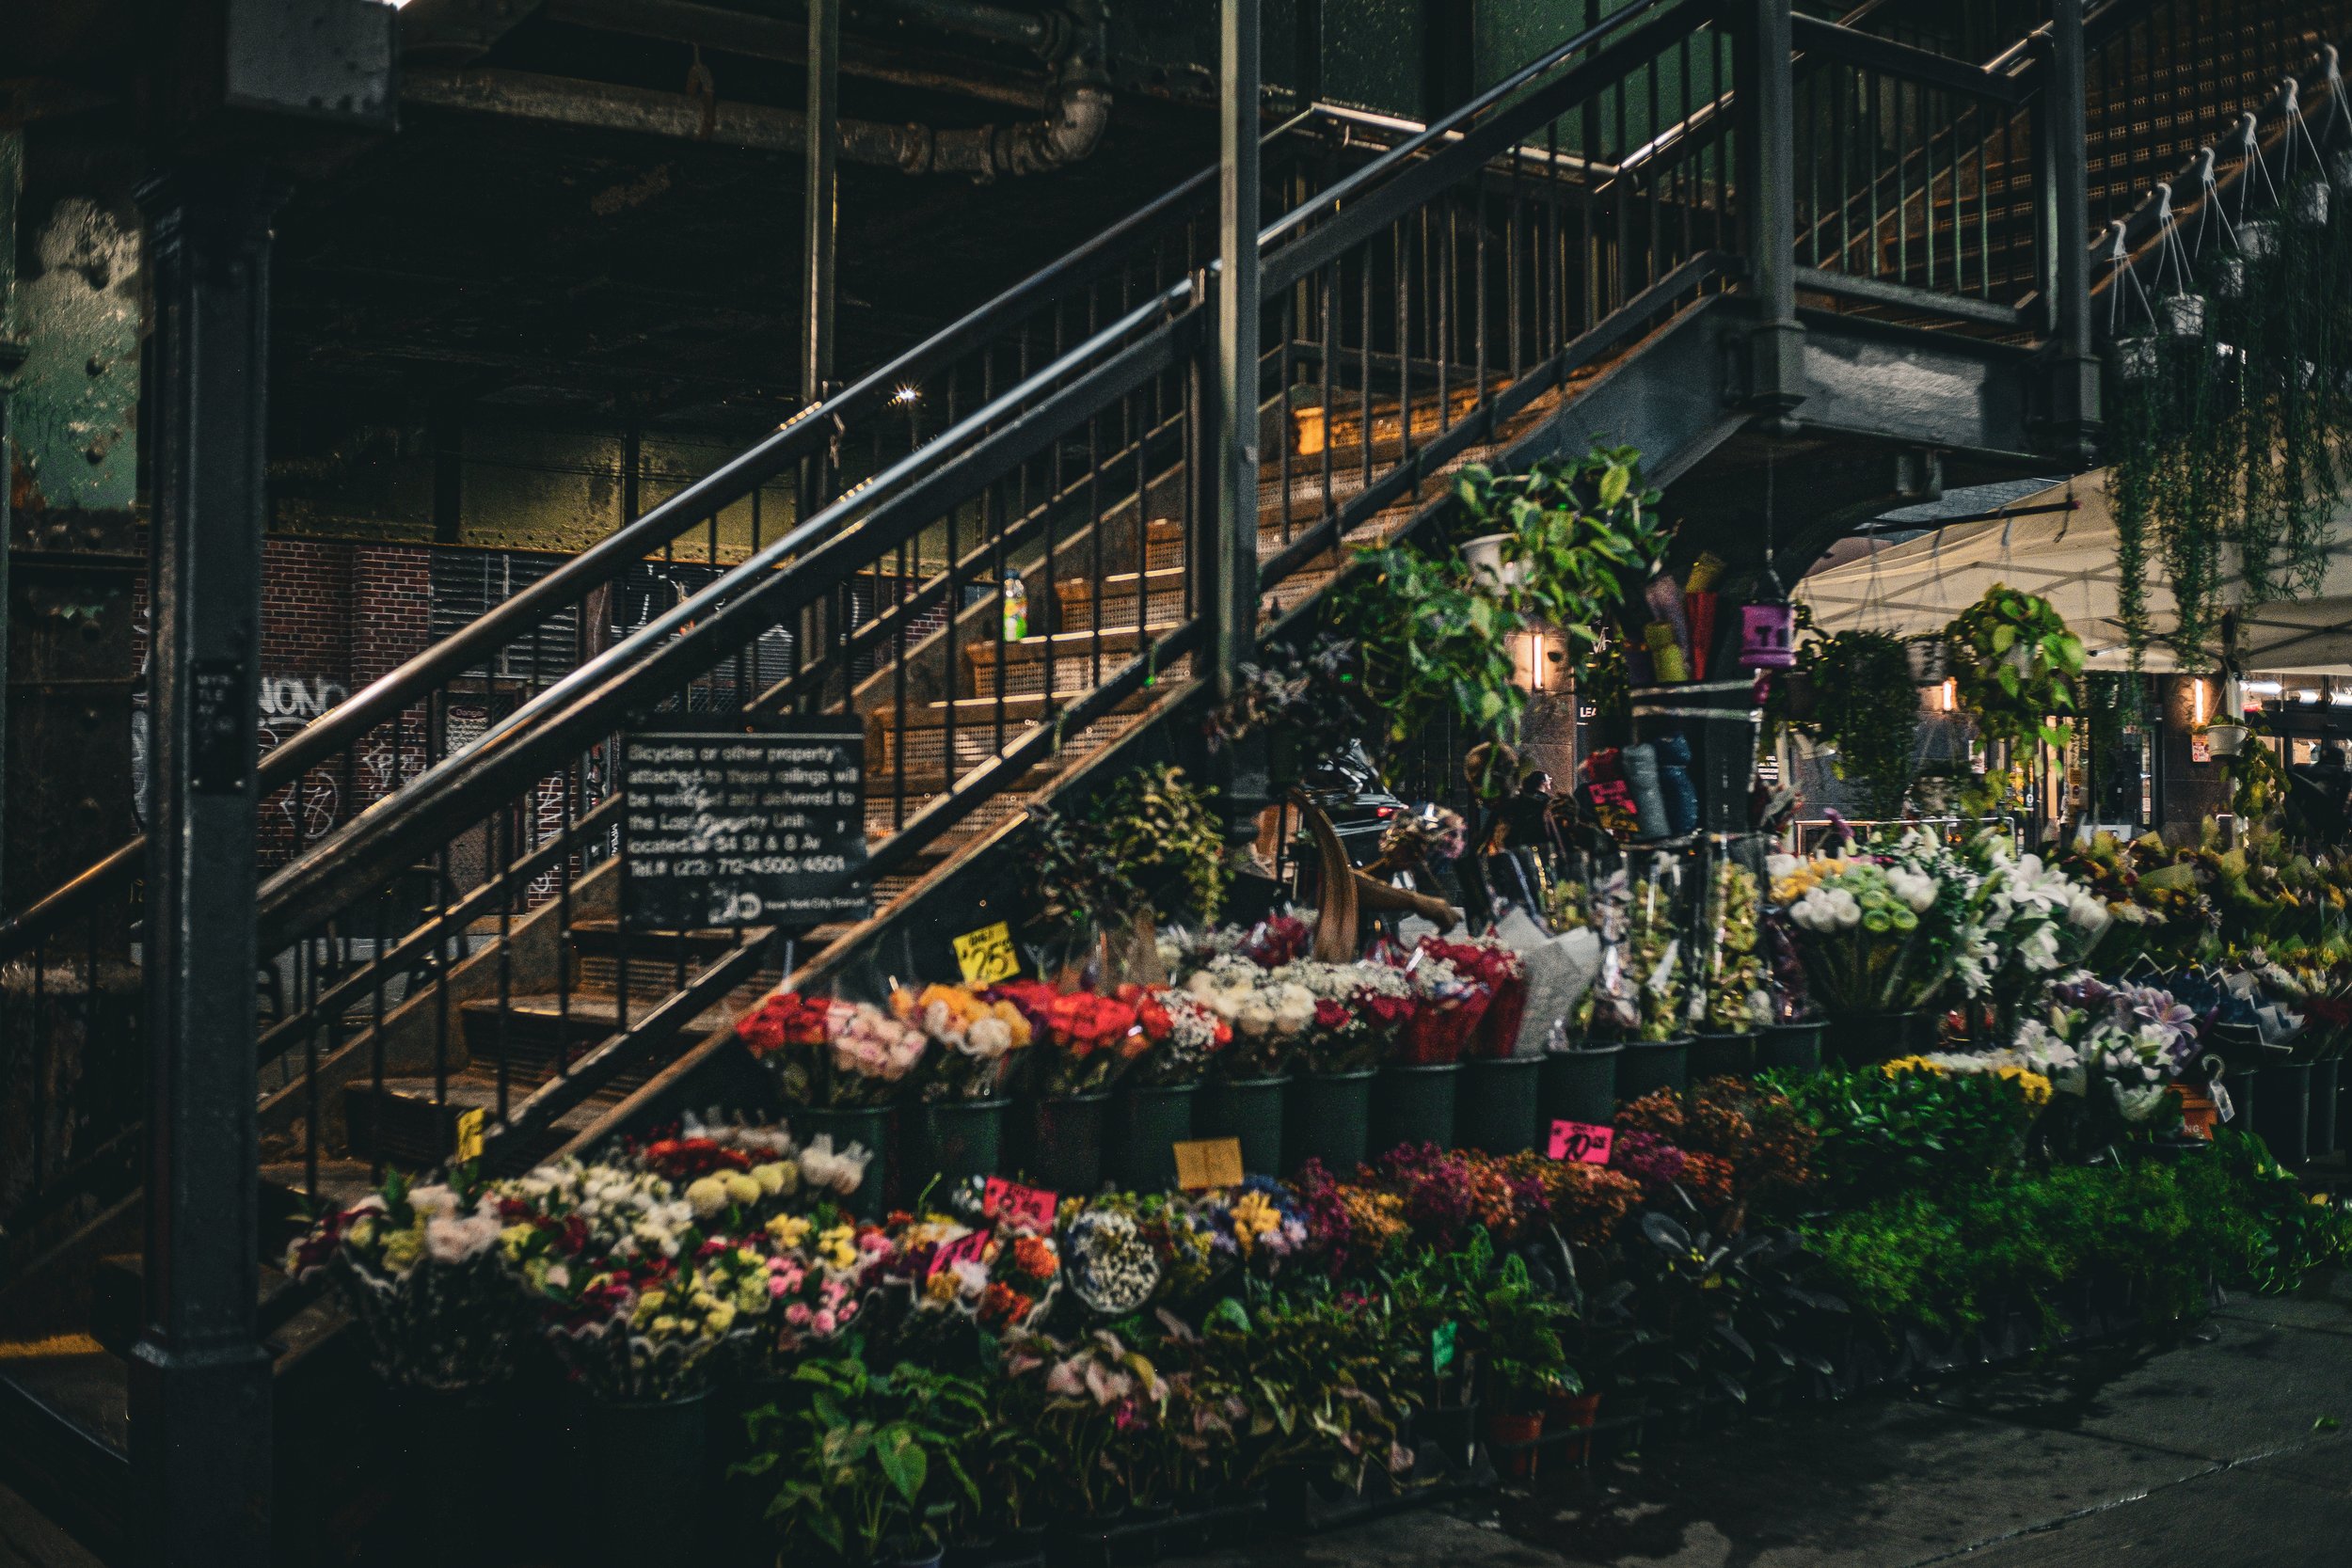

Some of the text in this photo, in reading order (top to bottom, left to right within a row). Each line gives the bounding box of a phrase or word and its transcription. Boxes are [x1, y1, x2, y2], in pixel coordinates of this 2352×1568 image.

[628, 744, 835, 765] Bicycles or other property
[628, 768, 702, 784] attached
[704, 769, 723, 784] to
[775, 768, 830, 787] railings
[834, 768, 860, 784] will
[628, 791, 650, 808] be
[761, 790, 834, 807] delivered
[837, 791, 856, 806] to
[628, 815, 656, 831] the
[772, 813, 806, 829] Unit
[742, 834, 760, 852] St
[801, 833, 821, 850] Av
